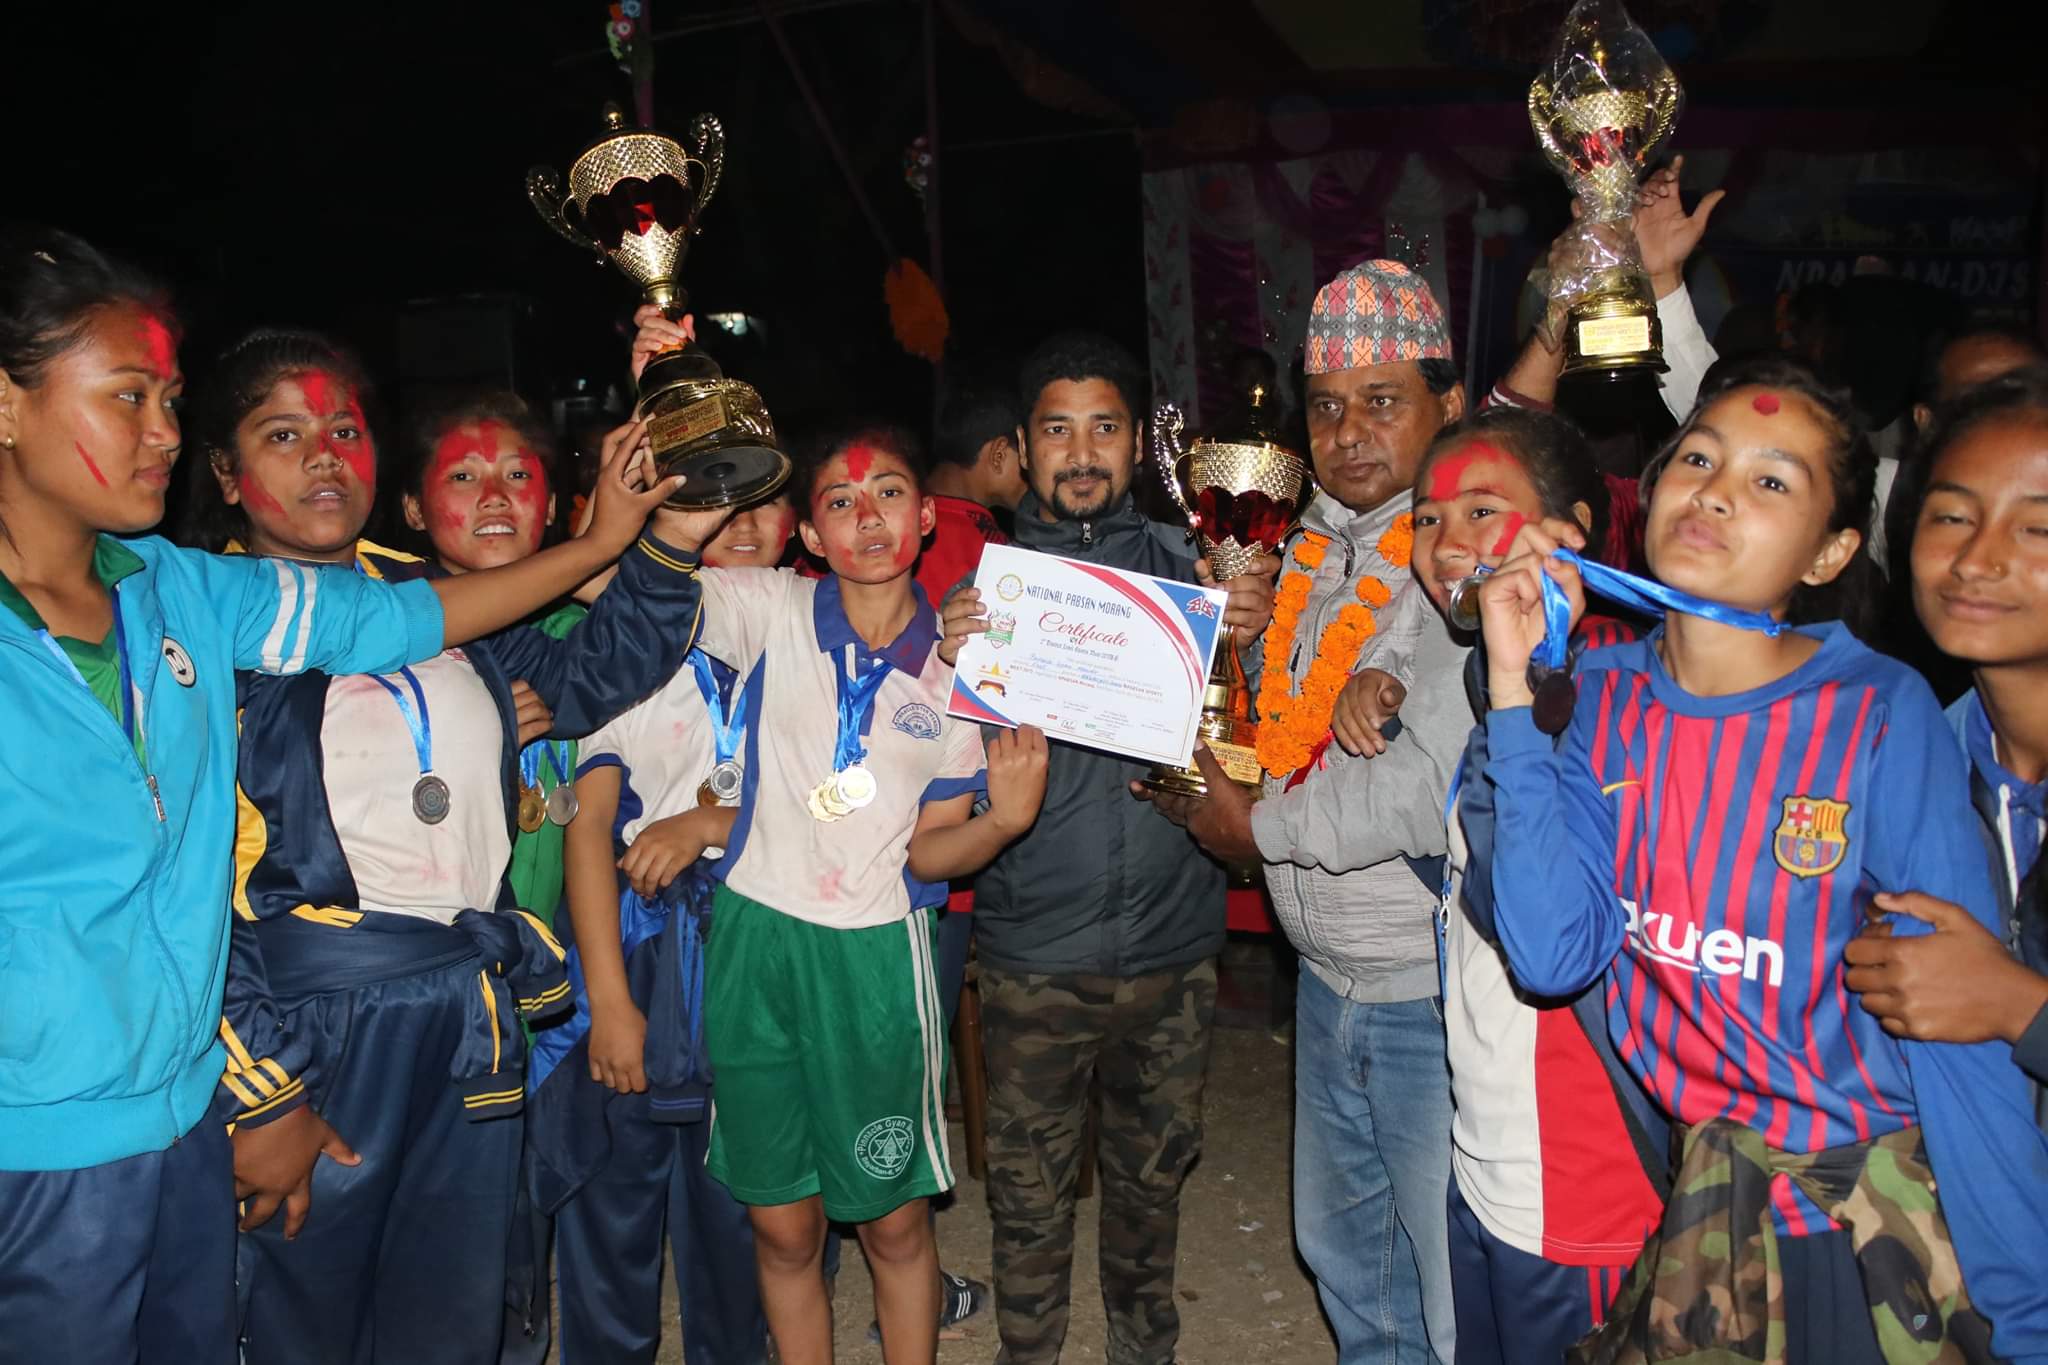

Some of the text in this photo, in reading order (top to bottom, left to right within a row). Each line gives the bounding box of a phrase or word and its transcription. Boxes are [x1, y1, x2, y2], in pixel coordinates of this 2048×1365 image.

[1025, 585, 1064, 604] NATIONAL
[1065, 592, 1096, 610] PABSAN
[1097, 602, 1133, 618] MORANG
[1039, 611, 1129, 647] Certificate
[857, 1119, 906, 1152] Pinnacle Gyan
